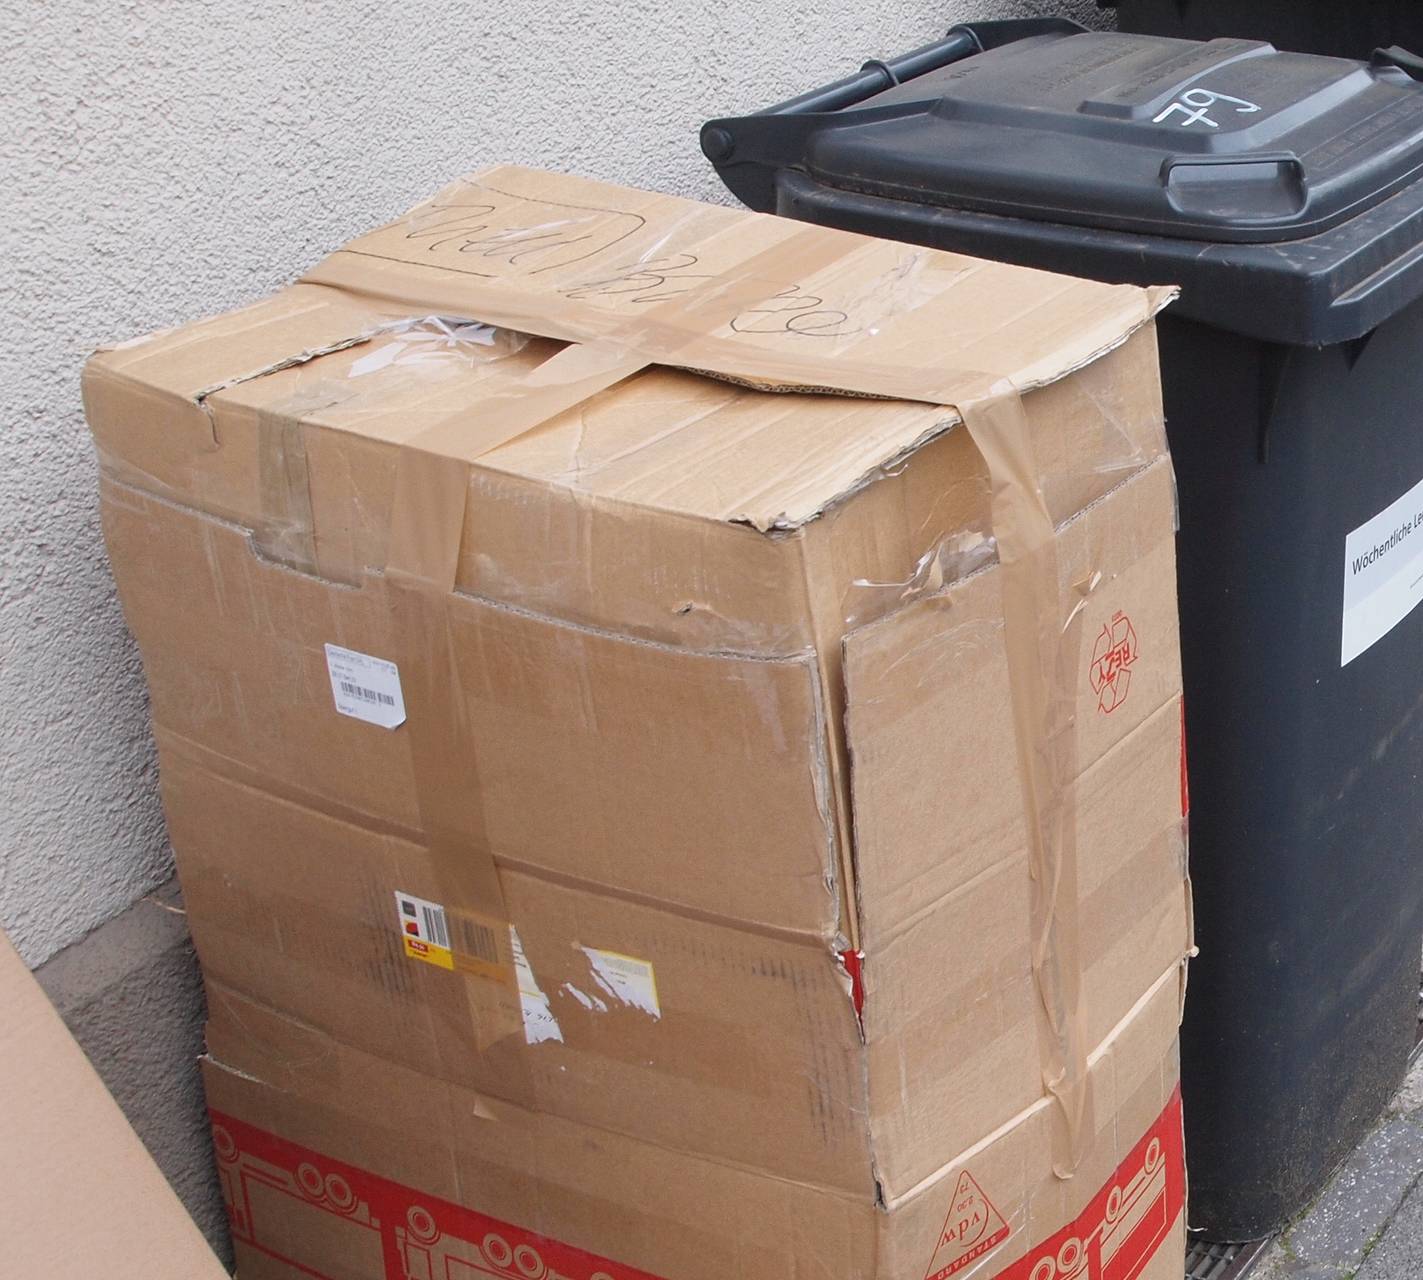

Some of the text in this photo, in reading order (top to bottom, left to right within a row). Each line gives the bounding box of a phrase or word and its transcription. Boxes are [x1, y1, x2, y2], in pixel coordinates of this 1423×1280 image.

[1152, 87, 1262, 128] 79
[1351, 520, 1412, 576] Wöchentliche
[937, 1235, 998, 1280] STANDARD
